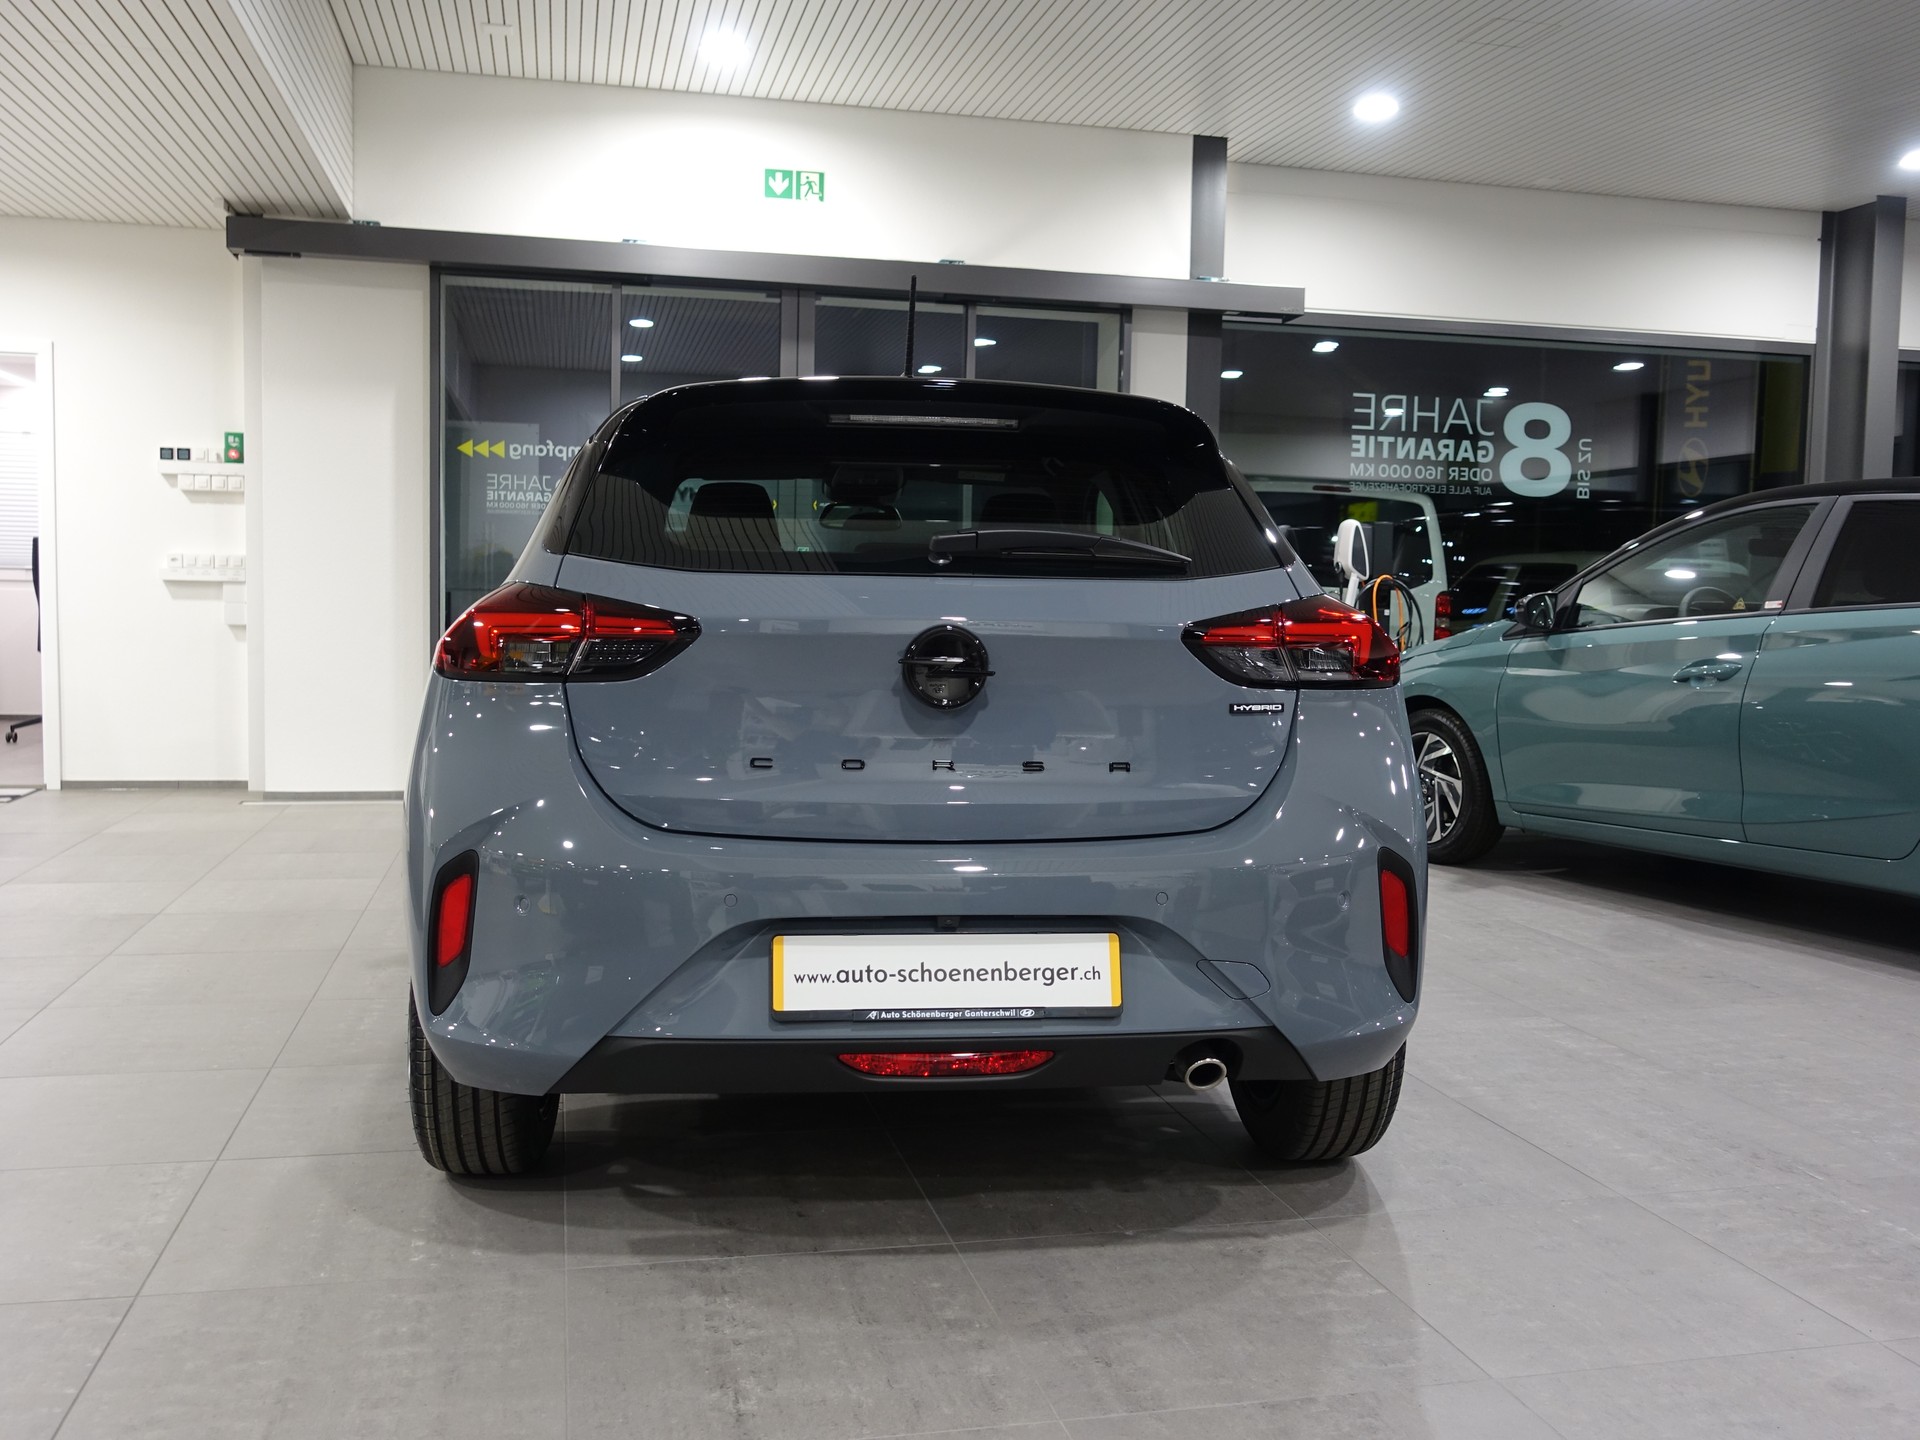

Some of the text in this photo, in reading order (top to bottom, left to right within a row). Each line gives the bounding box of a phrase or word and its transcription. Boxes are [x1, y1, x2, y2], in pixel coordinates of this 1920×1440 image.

[750, 757, 1131, 773] CORSA
[793, 961, 1101, 986] www.auto-schoenenberger.ch
[881, 1009, 1016, 1019] Auto Schönenberger Ganterschwil
